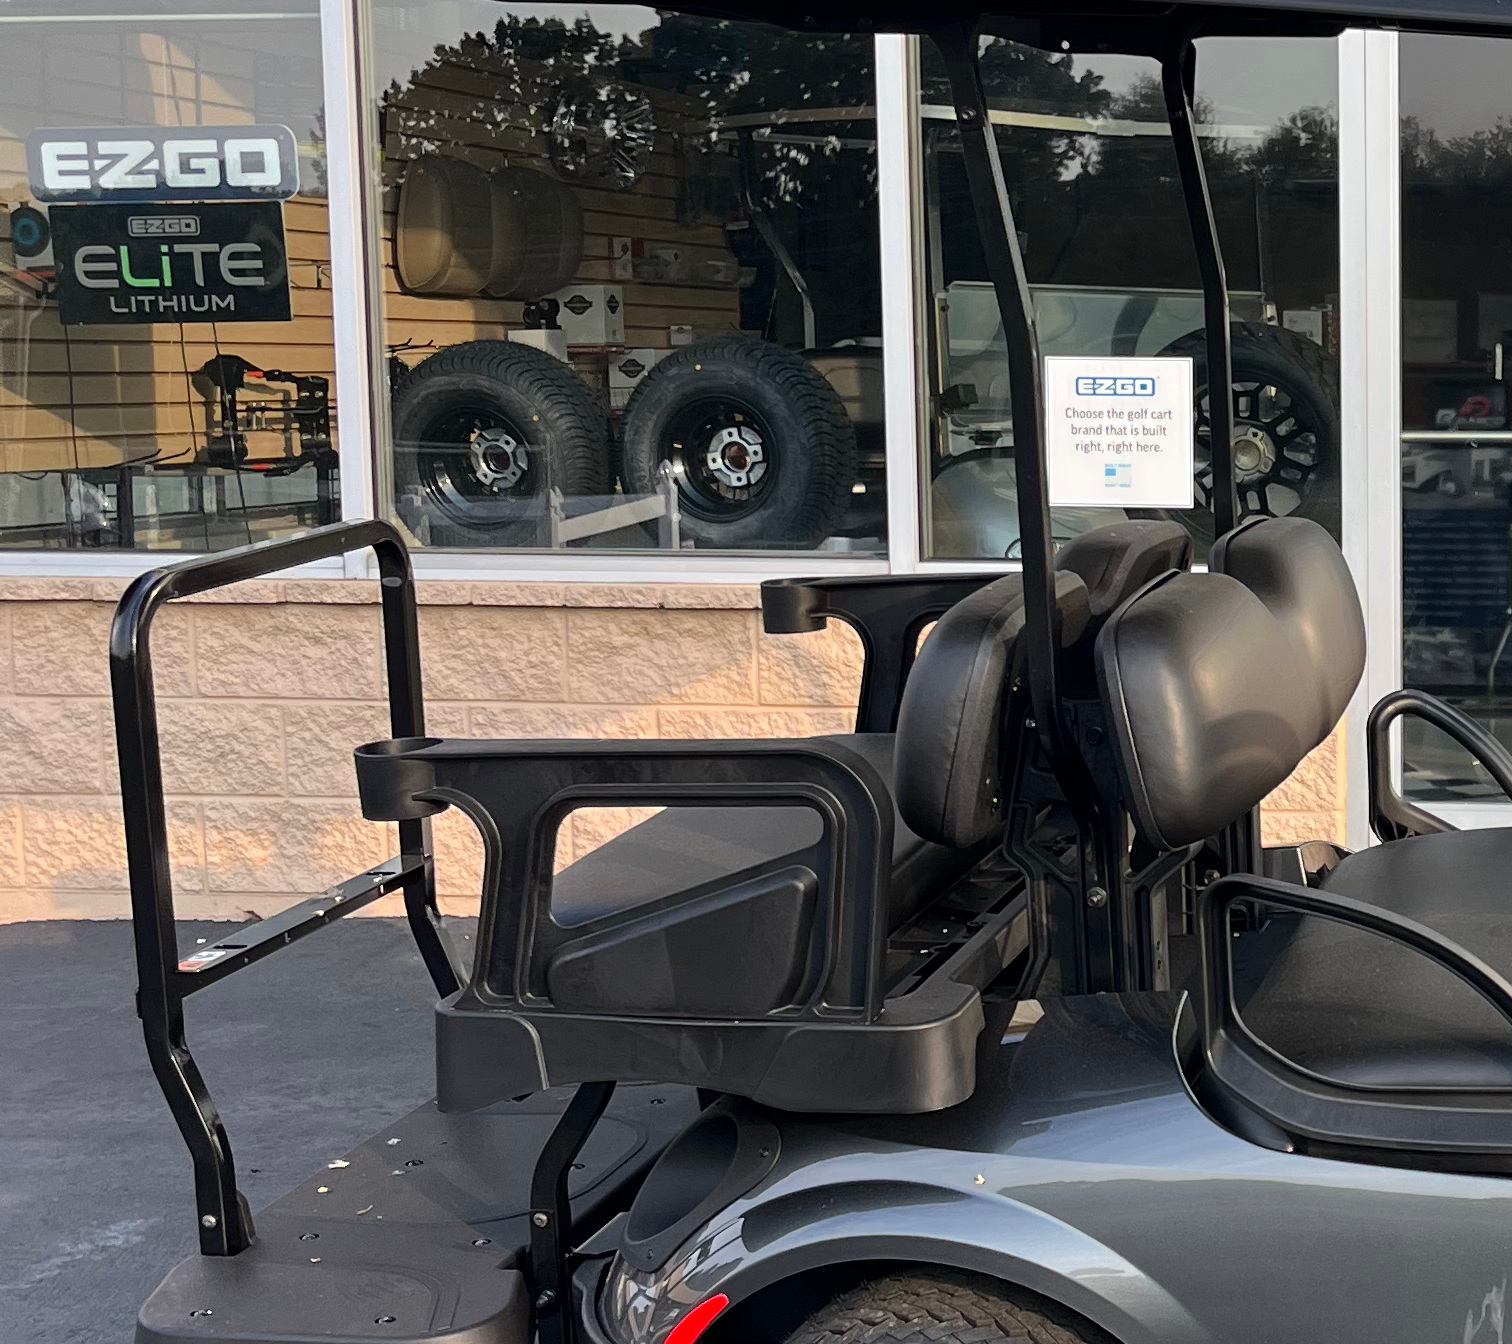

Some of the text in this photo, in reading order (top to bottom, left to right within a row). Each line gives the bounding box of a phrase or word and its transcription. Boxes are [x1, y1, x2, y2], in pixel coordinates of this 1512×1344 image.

[40, 137, 282, 189] EZGO
[130, 218, 198, 235] EZGO
[110, 294, 236, 314] LITHIUM
[1077, 377, 1154, 396] EZGO
[1065, 407, 1173, 421] Choose the golf cart
[1070, 424, 1167, 437] brand that is built
[1075, 441, 1163, 454] right, right here.
